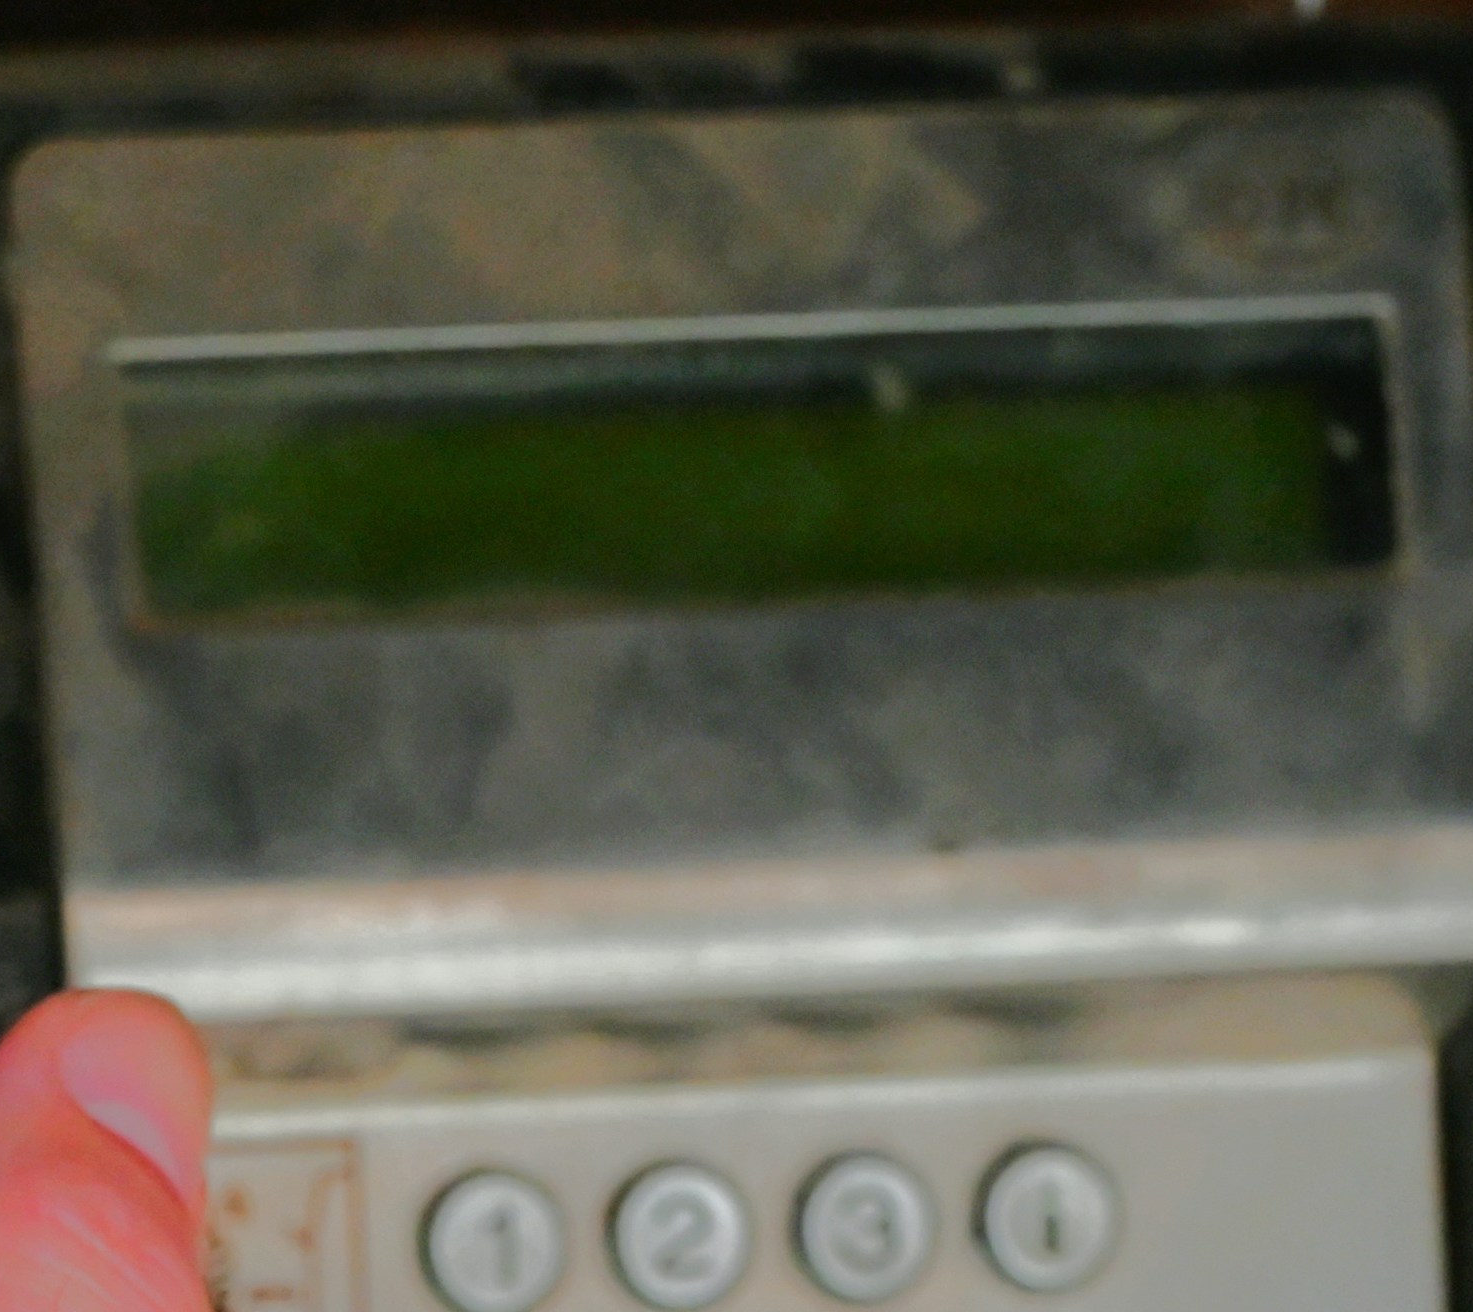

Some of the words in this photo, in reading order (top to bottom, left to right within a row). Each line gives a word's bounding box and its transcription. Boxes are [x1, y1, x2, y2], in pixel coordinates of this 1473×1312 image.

[472, 1196, 520, 1292] 1
[648, 1187, 716, 1283] 2
[829, 1181, 906, 1279] 3
